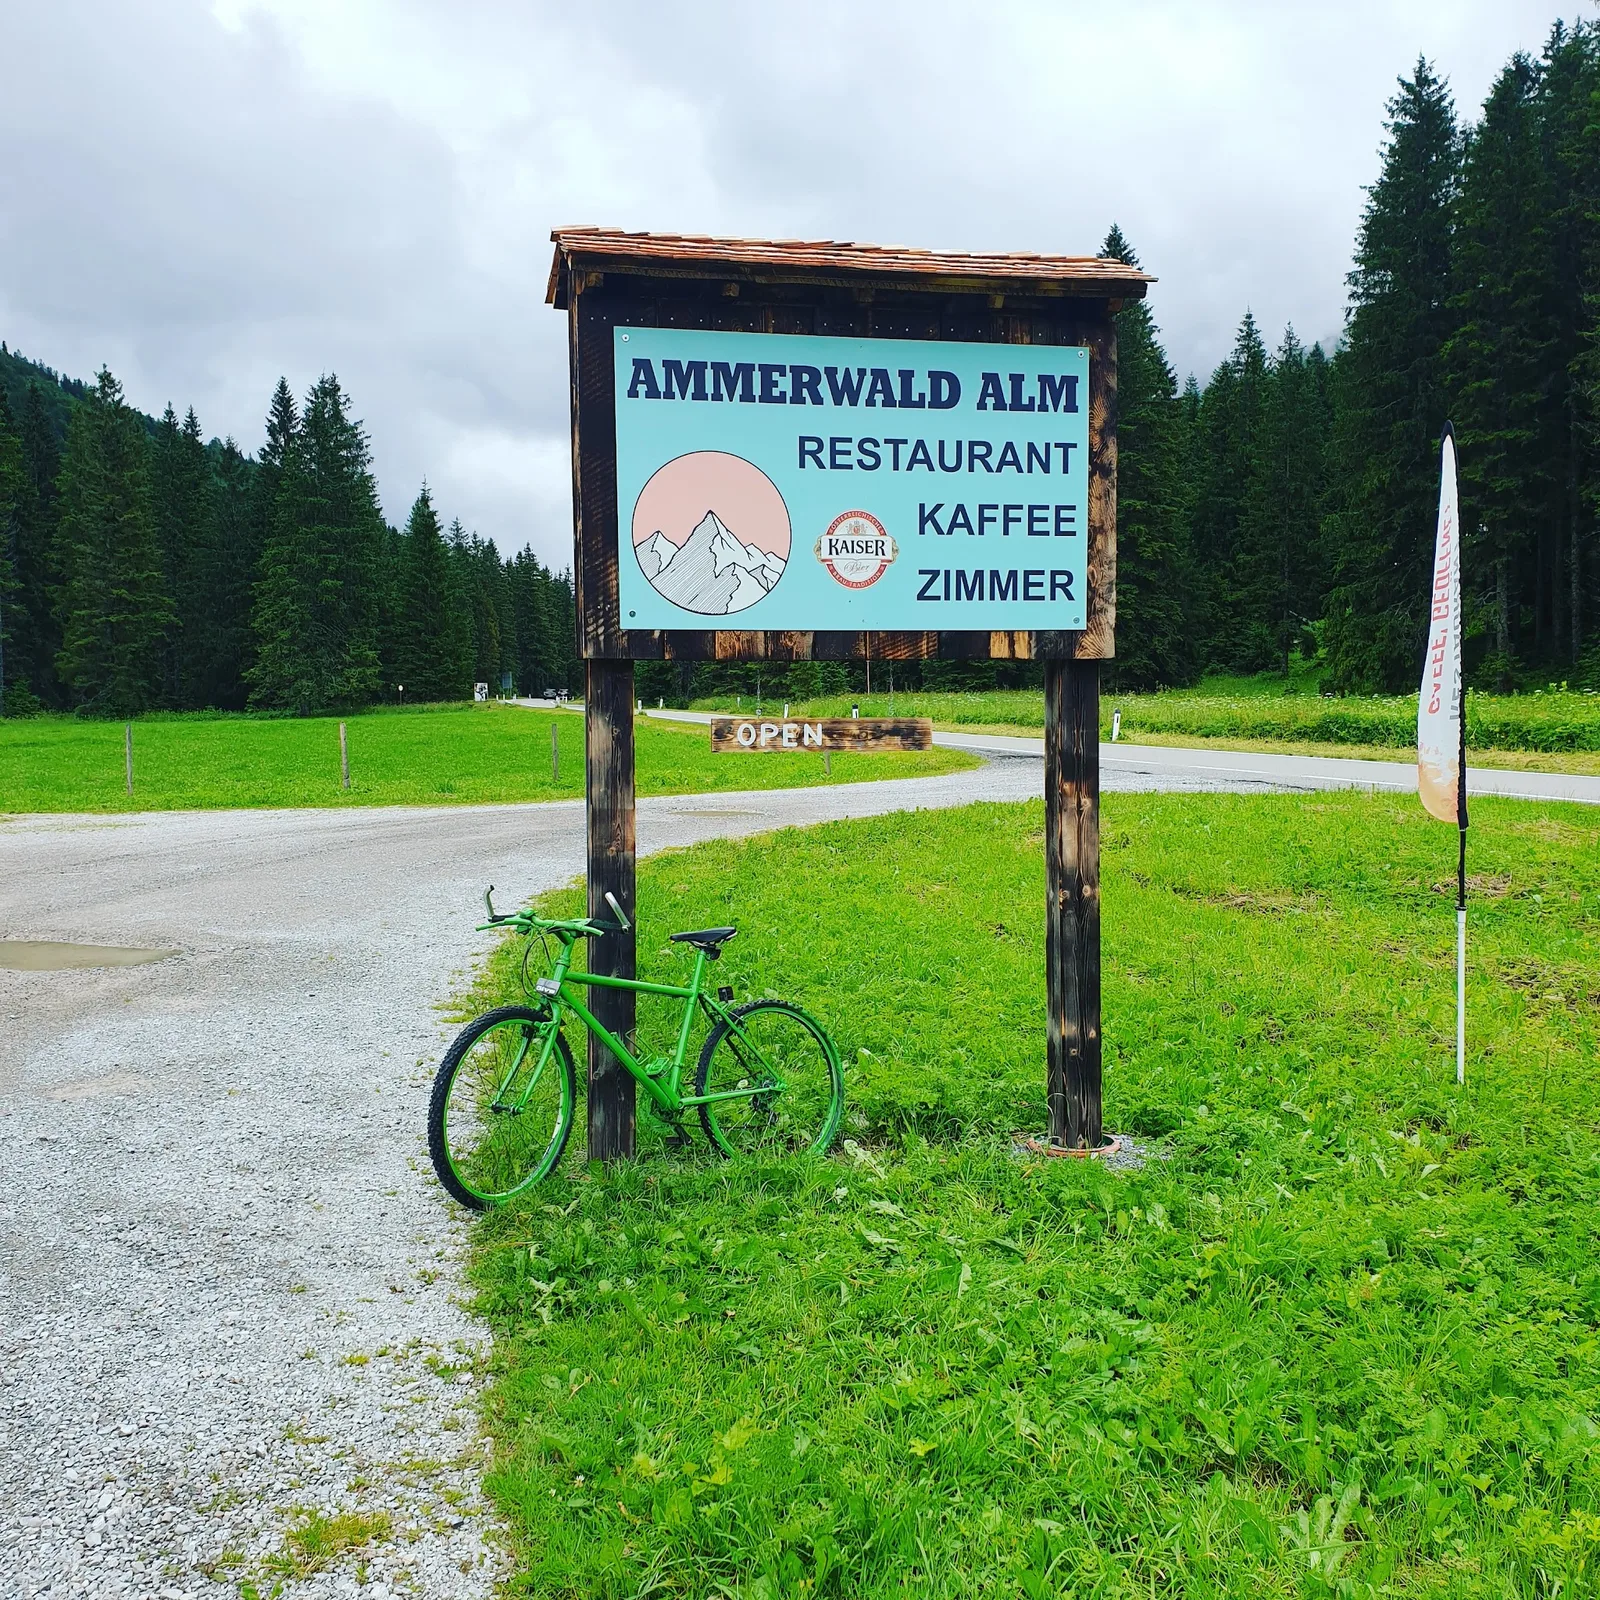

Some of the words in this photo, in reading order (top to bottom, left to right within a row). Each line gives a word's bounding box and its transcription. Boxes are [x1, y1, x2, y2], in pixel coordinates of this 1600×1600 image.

[628, 358, 961, 409] AMMERWALD
[977, 372, 1078, 413] ALM
[799, 436, 1077, 474] RESTAURANT
[919, 503, 1076, 536] KAFFEE
[828, 538, 886, 556] KAISER
[917, 570, 1074, 600] ZIMMER
[736, 723, 823, 747] OPEN
